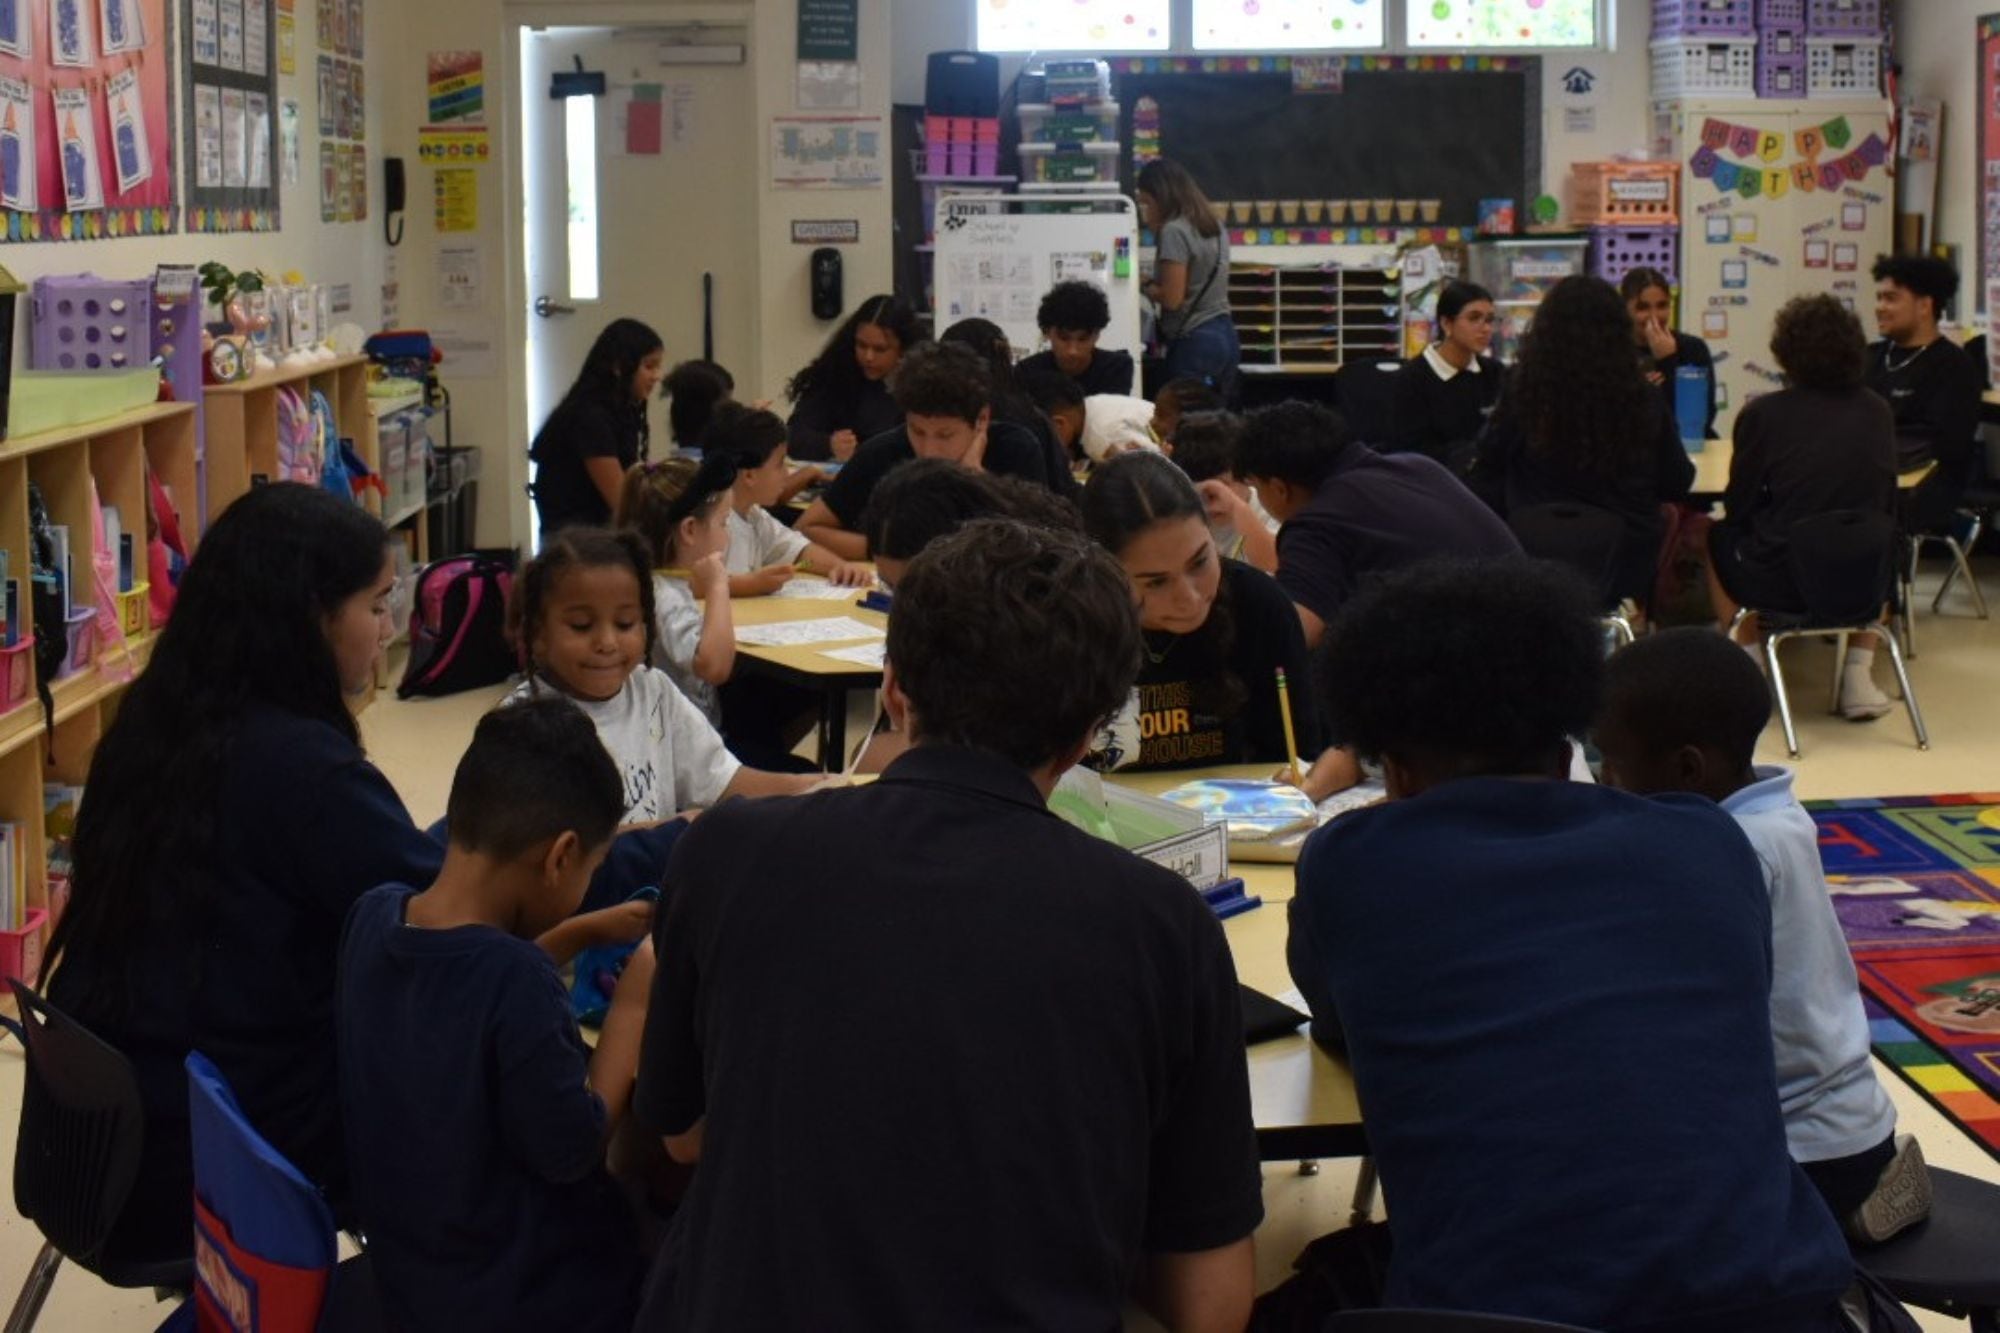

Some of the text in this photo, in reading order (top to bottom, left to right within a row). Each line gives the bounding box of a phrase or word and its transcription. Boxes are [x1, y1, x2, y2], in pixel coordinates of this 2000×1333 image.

[1709, 126, 1842, 155] HAPPY
[1140, 681, 1192, 711] THIS
[1140, 706, 1190, 741] OUR
[1140, 729, 1224, 766] HOUSE
